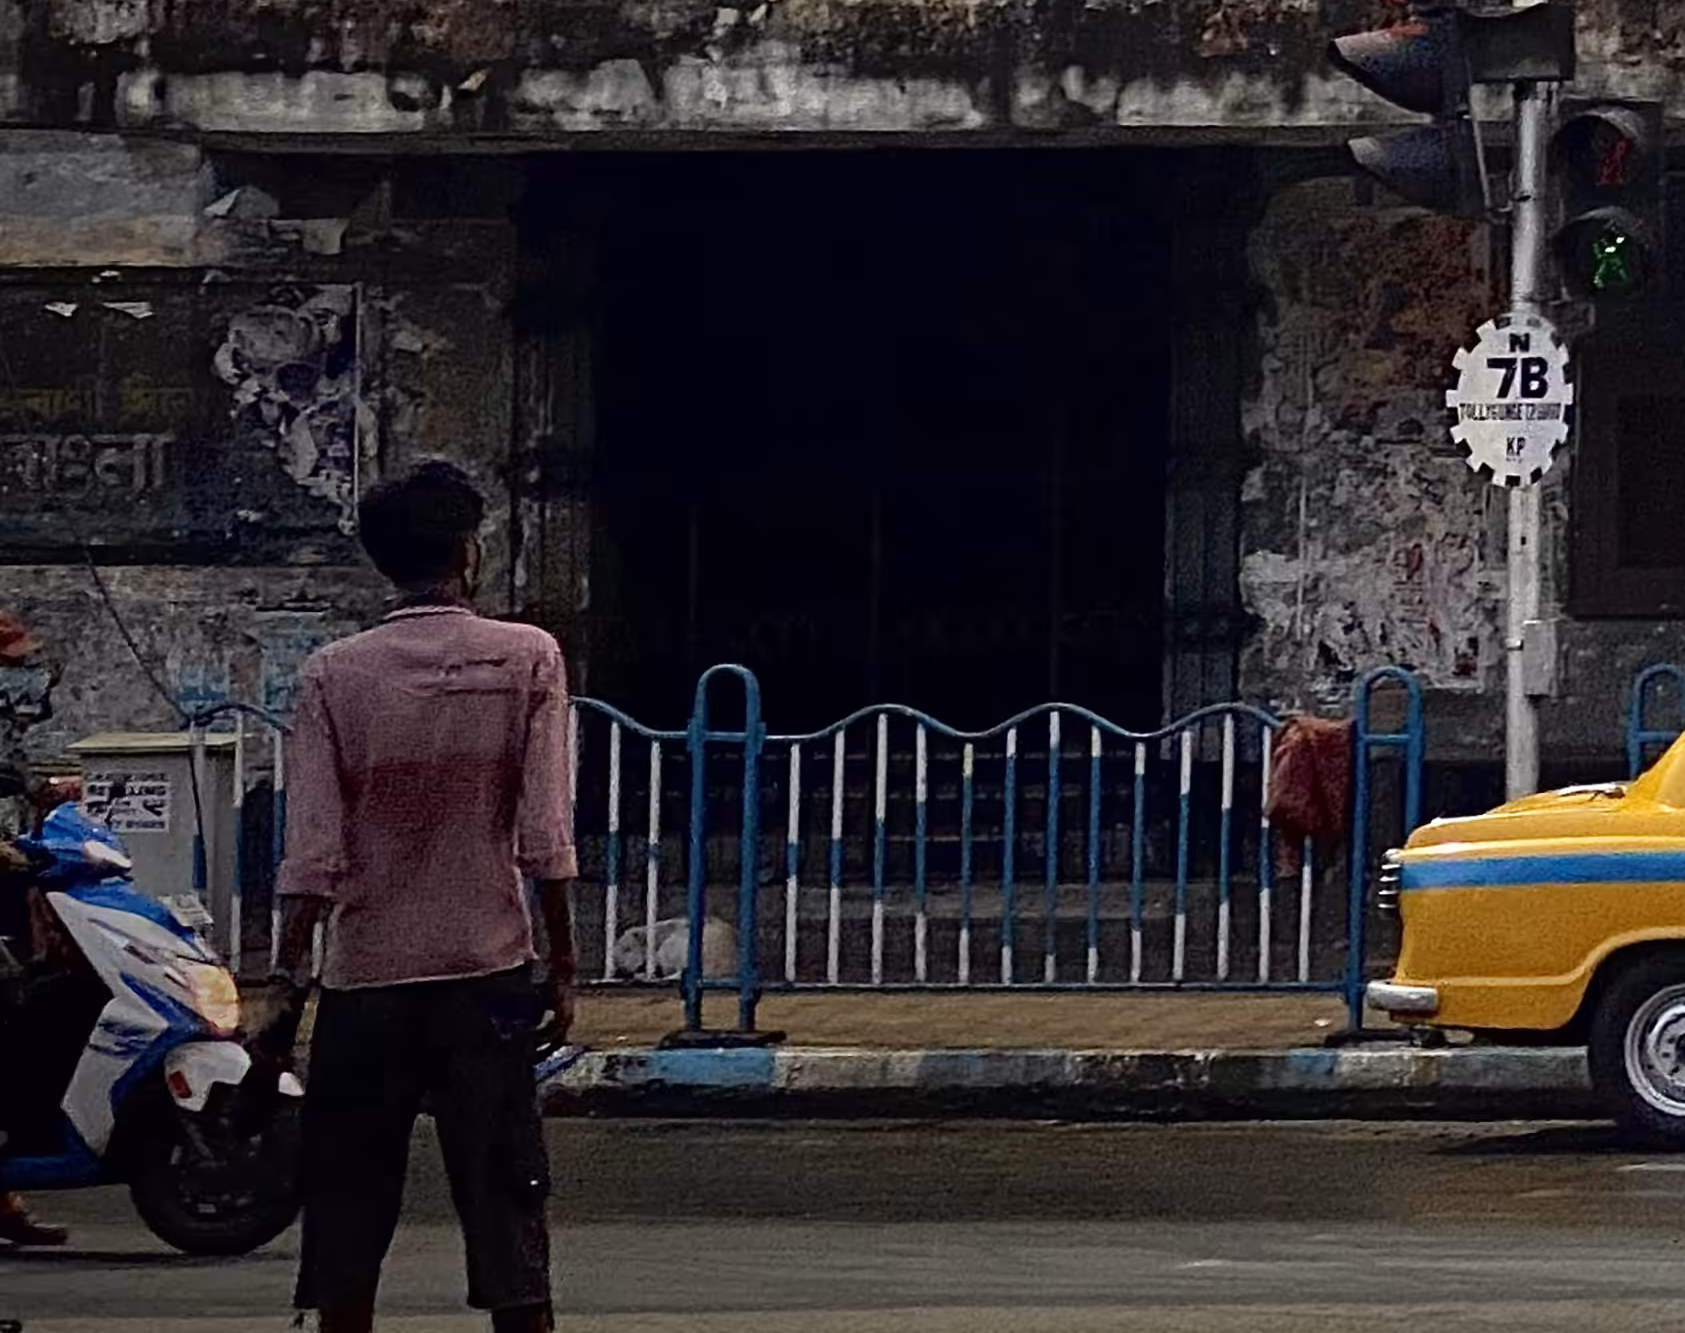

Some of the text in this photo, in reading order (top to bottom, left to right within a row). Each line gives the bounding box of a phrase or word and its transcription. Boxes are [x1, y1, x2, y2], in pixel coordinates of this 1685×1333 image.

[1509, 333, 1530, 352] N
[1486, 357, 1549, 399] 7B
[1506, 437, 1526, 456] KP
